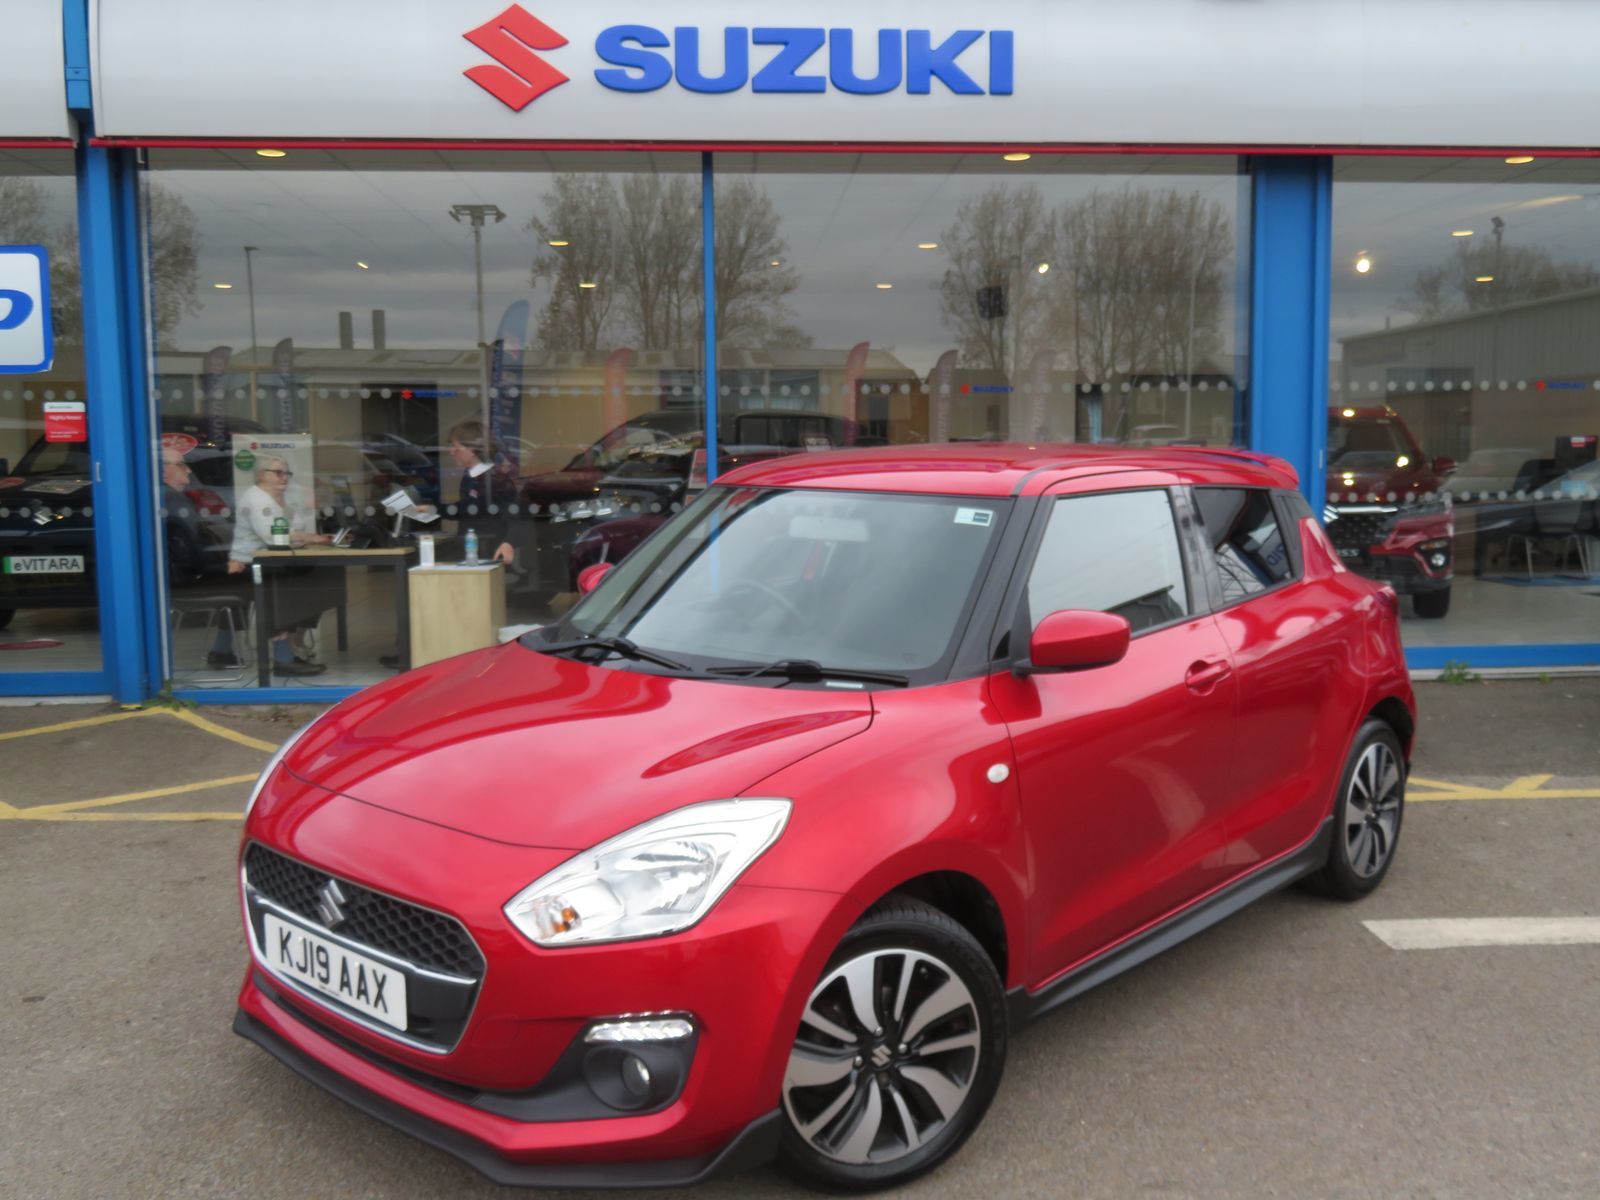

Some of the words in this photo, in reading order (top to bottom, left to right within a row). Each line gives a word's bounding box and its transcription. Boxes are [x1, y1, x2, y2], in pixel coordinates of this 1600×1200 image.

[594, 25, 1014, 95] SUZUKI
[279, 926, 330, 985] KJ19
[339, 955, 389, 1014] AAX
